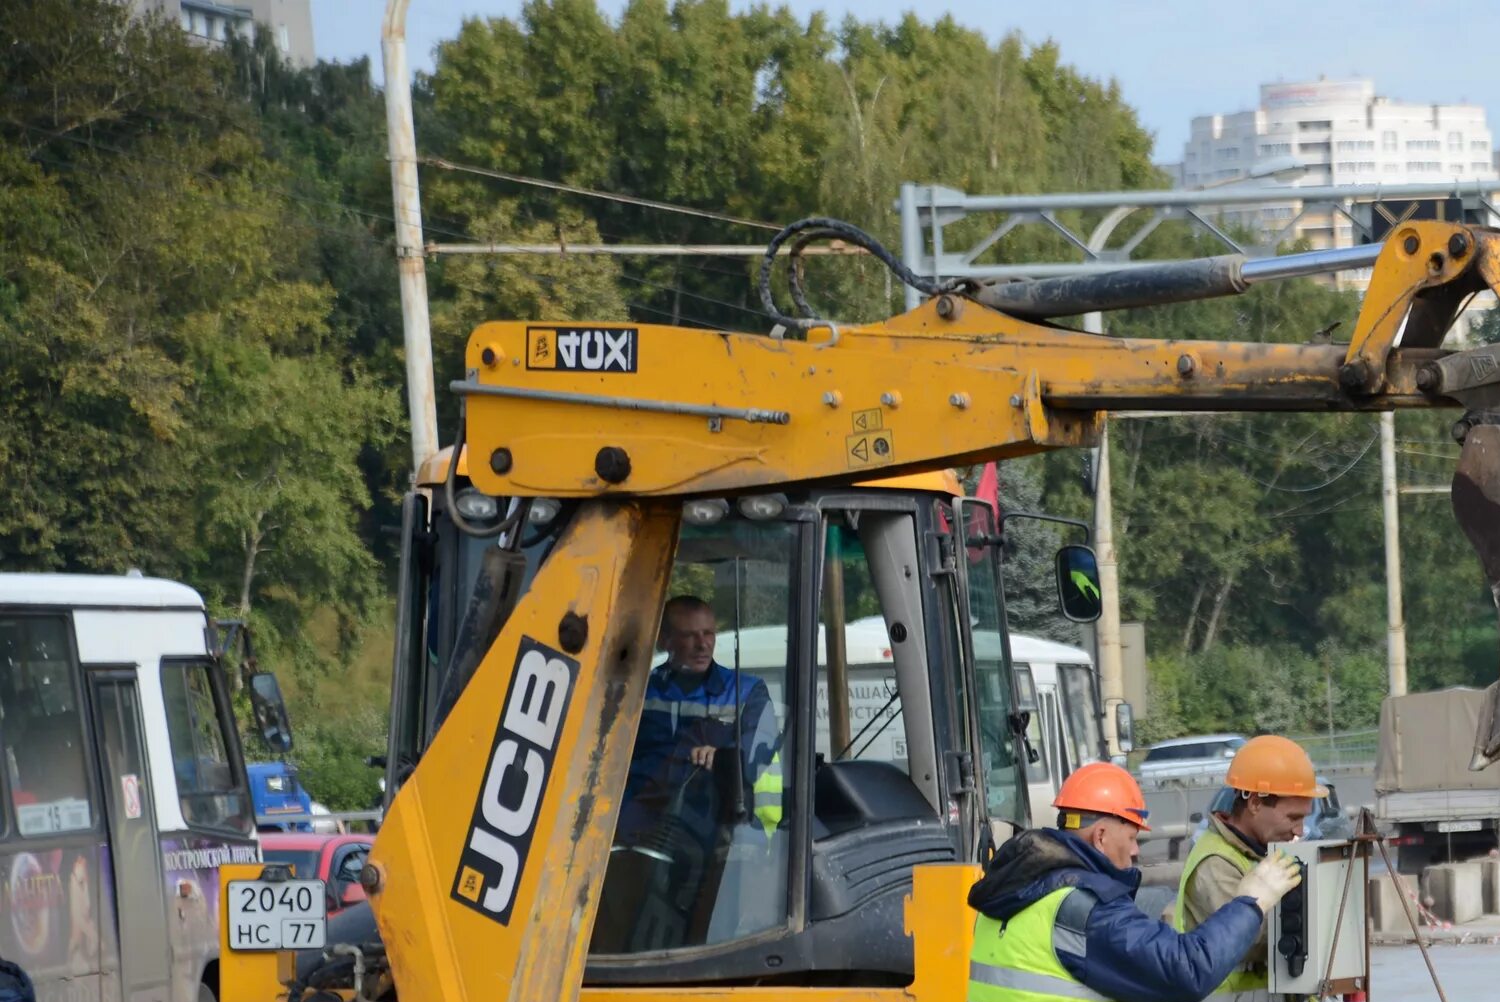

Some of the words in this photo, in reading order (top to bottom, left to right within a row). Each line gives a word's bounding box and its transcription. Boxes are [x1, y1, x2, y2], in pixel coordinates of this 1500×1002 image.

[557, 330, 628, 371] 4CX
[470, 650, 570, 913] JCB
[241, 886, 312, 913] 2040
[289, 924, 316, 943] 77
